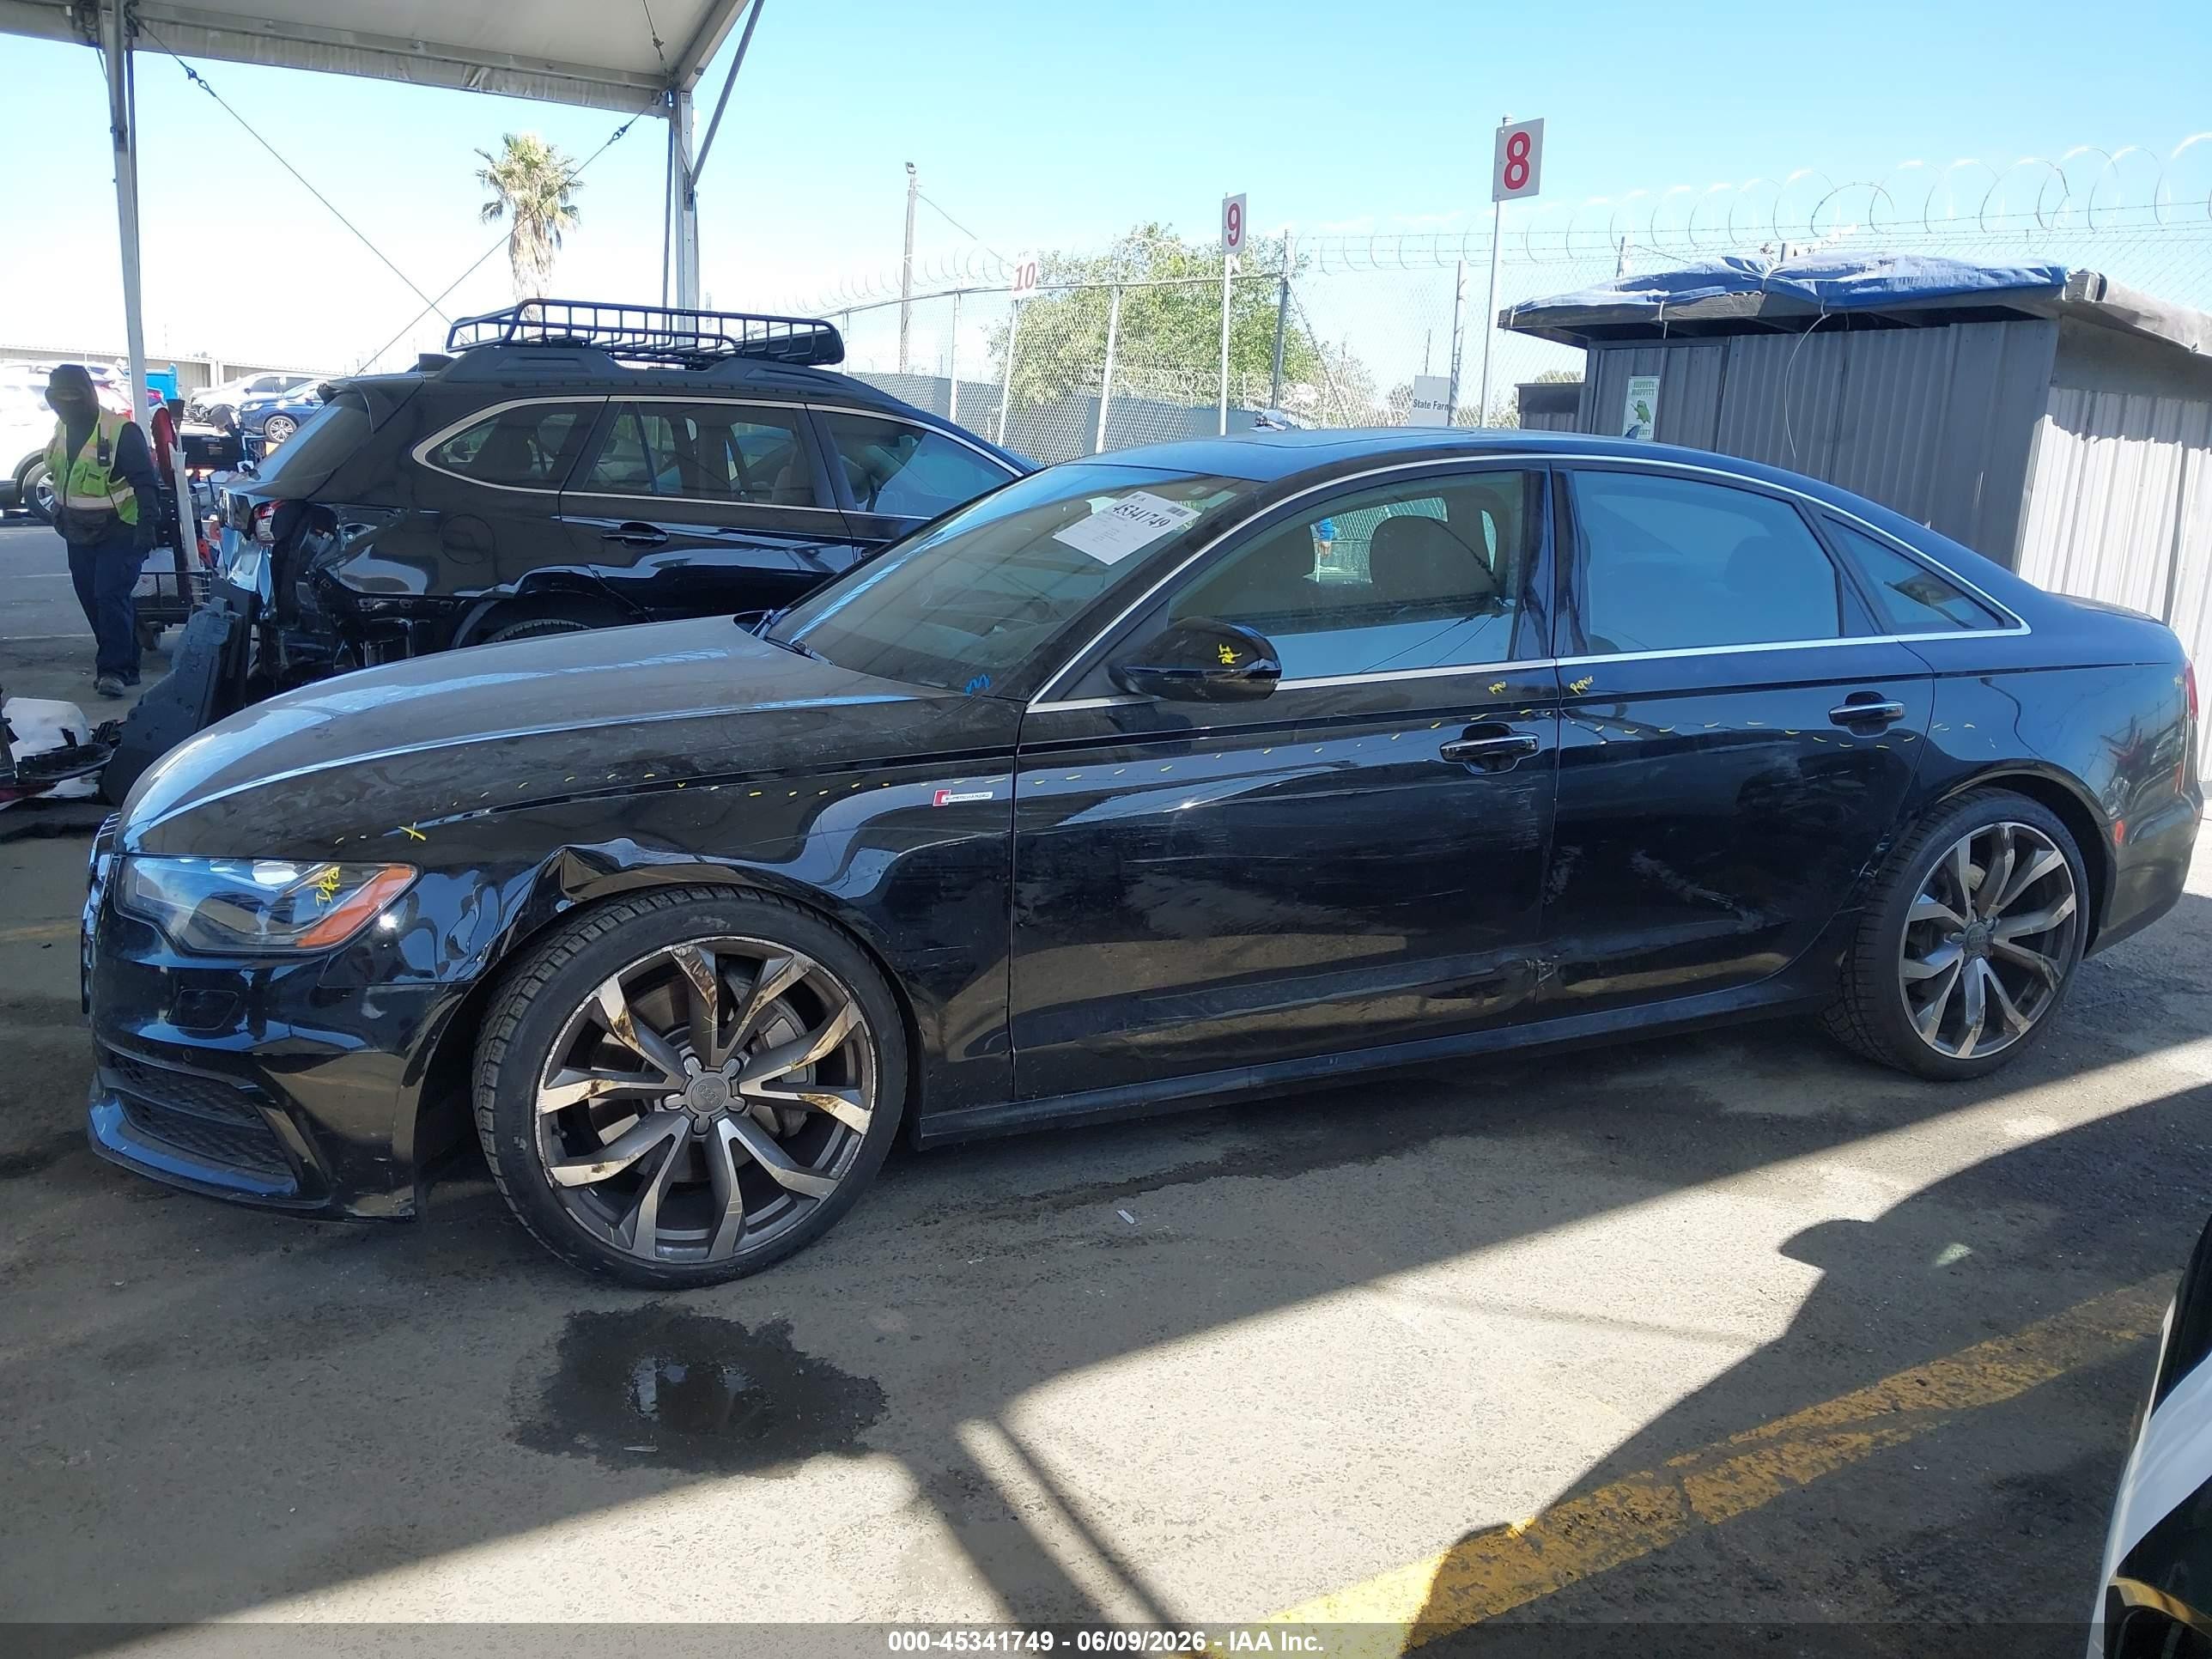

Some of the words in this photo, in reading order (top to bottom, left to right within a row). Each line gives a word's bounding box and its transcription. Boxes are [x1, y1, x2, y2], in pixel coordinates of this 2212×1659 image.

[1504, 131, 1531, 190] 8
[1227, 203, 1241, 246] 9
[1013, 262, 1036, 291] 10
[1413, 398, 1431, 410] State
[1113, 503, 1171, 529] 45341749
